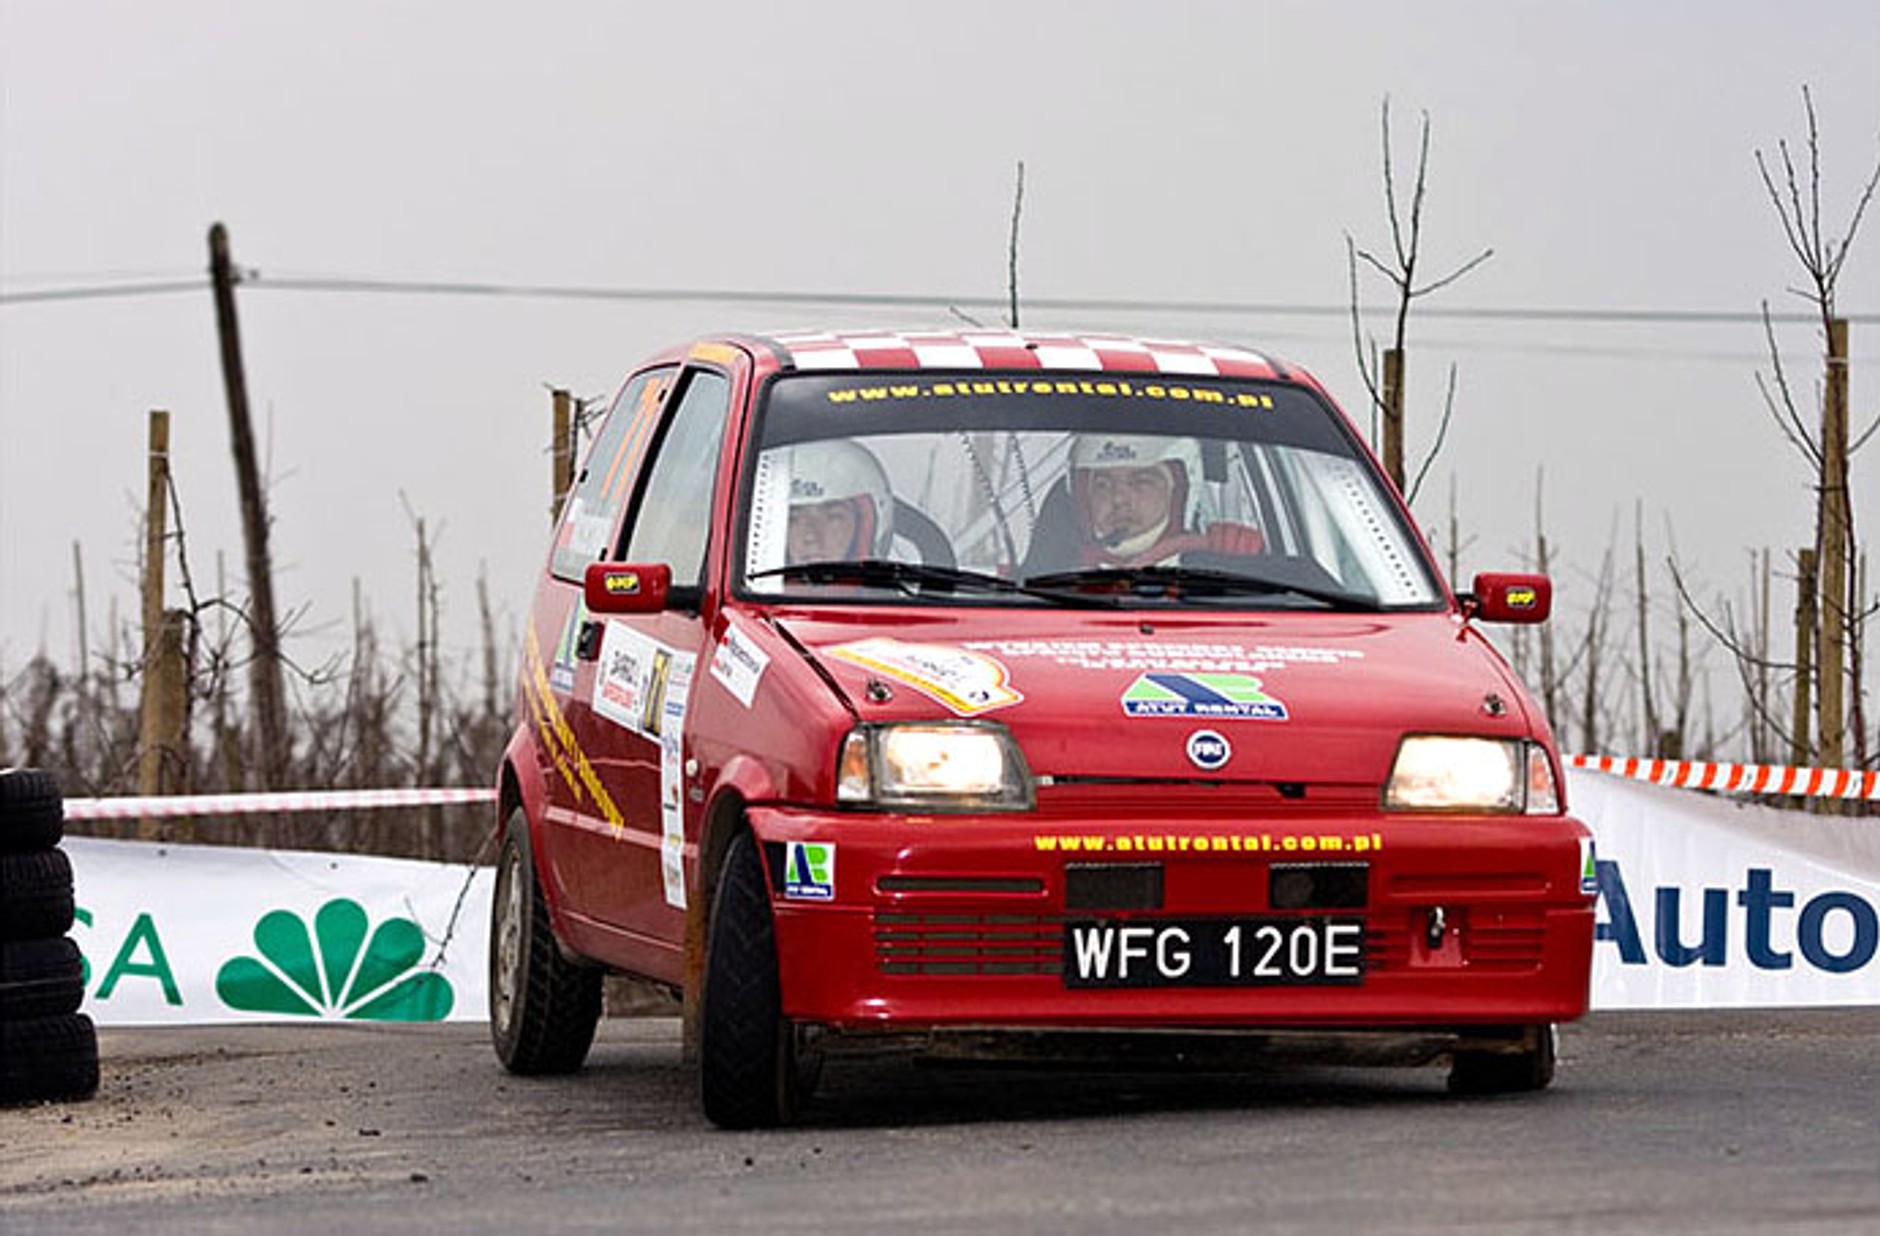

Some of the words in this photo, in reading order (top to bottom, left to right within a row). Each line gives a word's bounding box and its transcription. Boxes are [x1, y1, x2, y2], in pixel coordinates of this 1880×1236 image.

[1072, 926, 1192, 979] WFG
[1222, 924, 1362, 977] 120E
[1595, 860, 1879, 974] Auto
